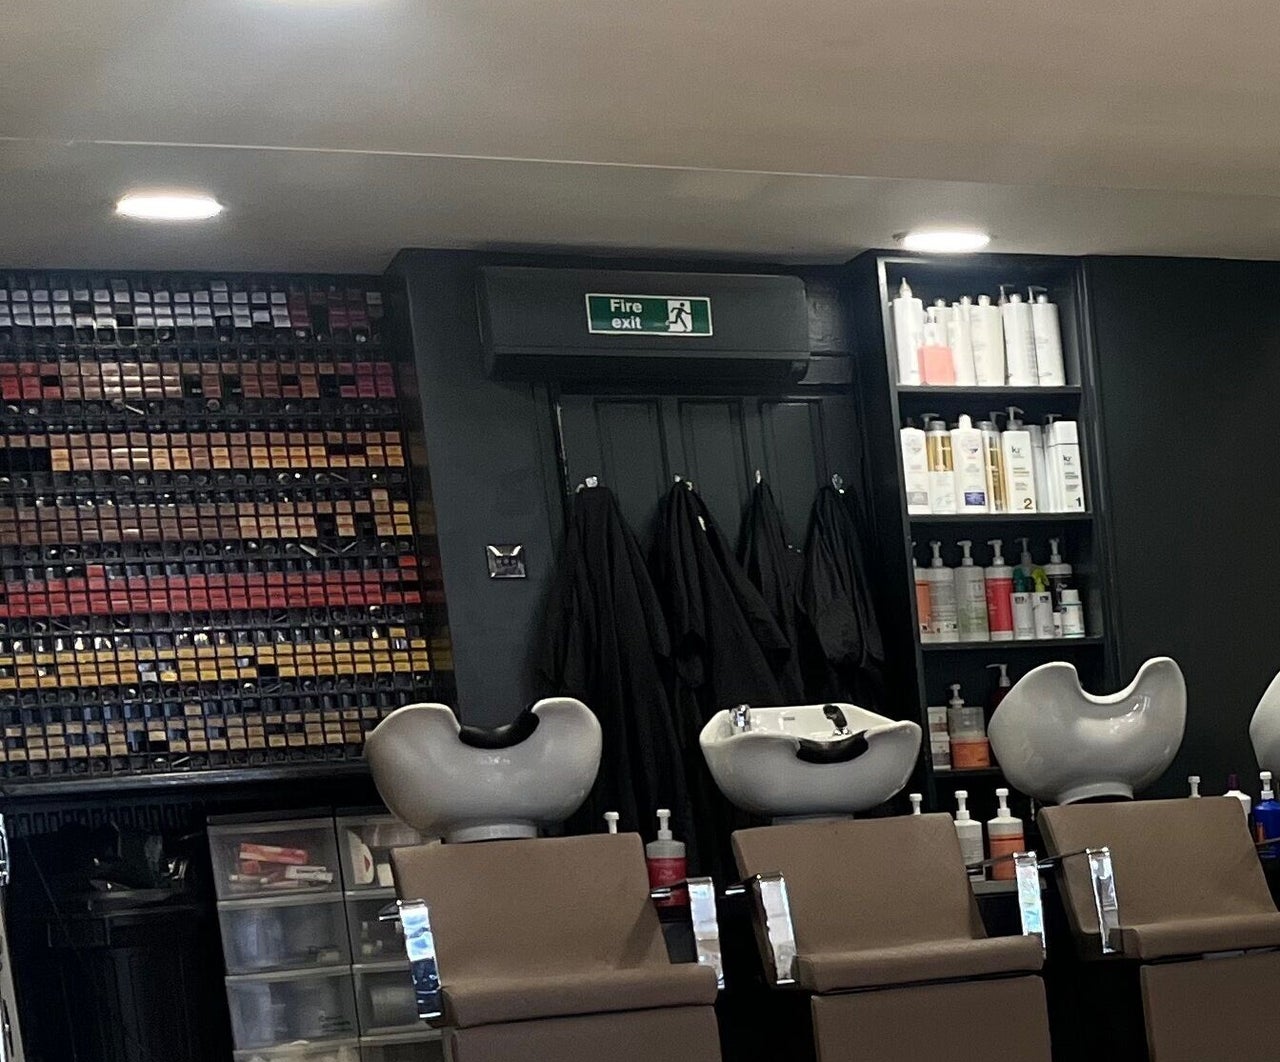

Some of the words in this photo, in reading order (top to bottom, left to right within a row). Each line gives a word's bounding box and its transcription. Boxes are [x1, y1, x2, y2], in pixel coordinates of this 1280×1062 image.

[610, 298, 643, 313] Fire
[611, 315, 643, 330] exit
[1024, 497, 1033, 510] 2
[1076, 497, 1082, 507] 1
